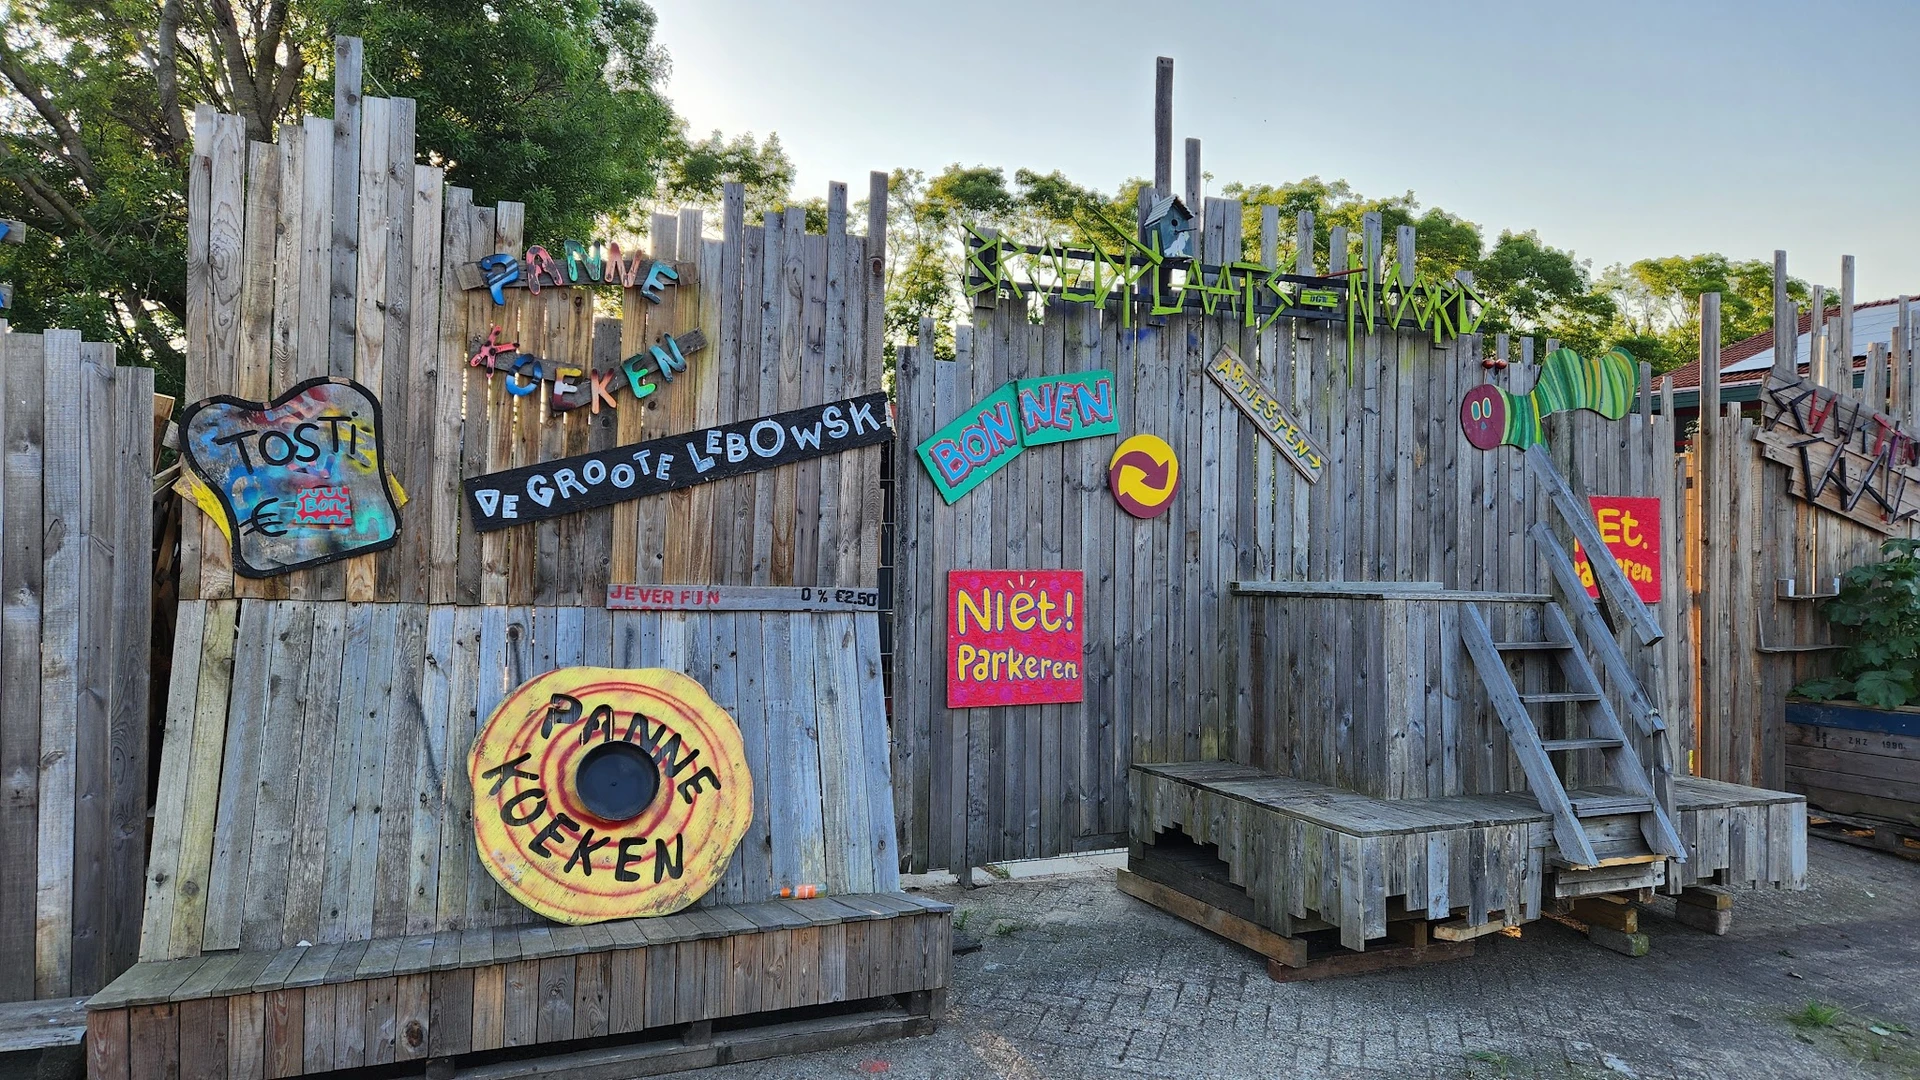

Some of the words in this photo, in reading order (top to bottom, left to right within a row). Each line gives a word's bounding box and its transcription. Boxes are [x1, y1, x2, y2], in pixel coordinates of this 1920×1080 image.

[480, 239, 679, 306] PANNE
[470, 325, 688, 415] KOEKEN
[475, 488, 519, 519] DE
[526, 449, 675, 508] GROOTE
[609, 585, 674, 604] JEVER
[680, 590, 720, 605] FUN
[835, 589, 877, 606] €2.50
[957, 643, 1078, 682] Parkeren
[540, 693, 722, 805] PANNE
[481, 752, 684, 884] KOEKEN
